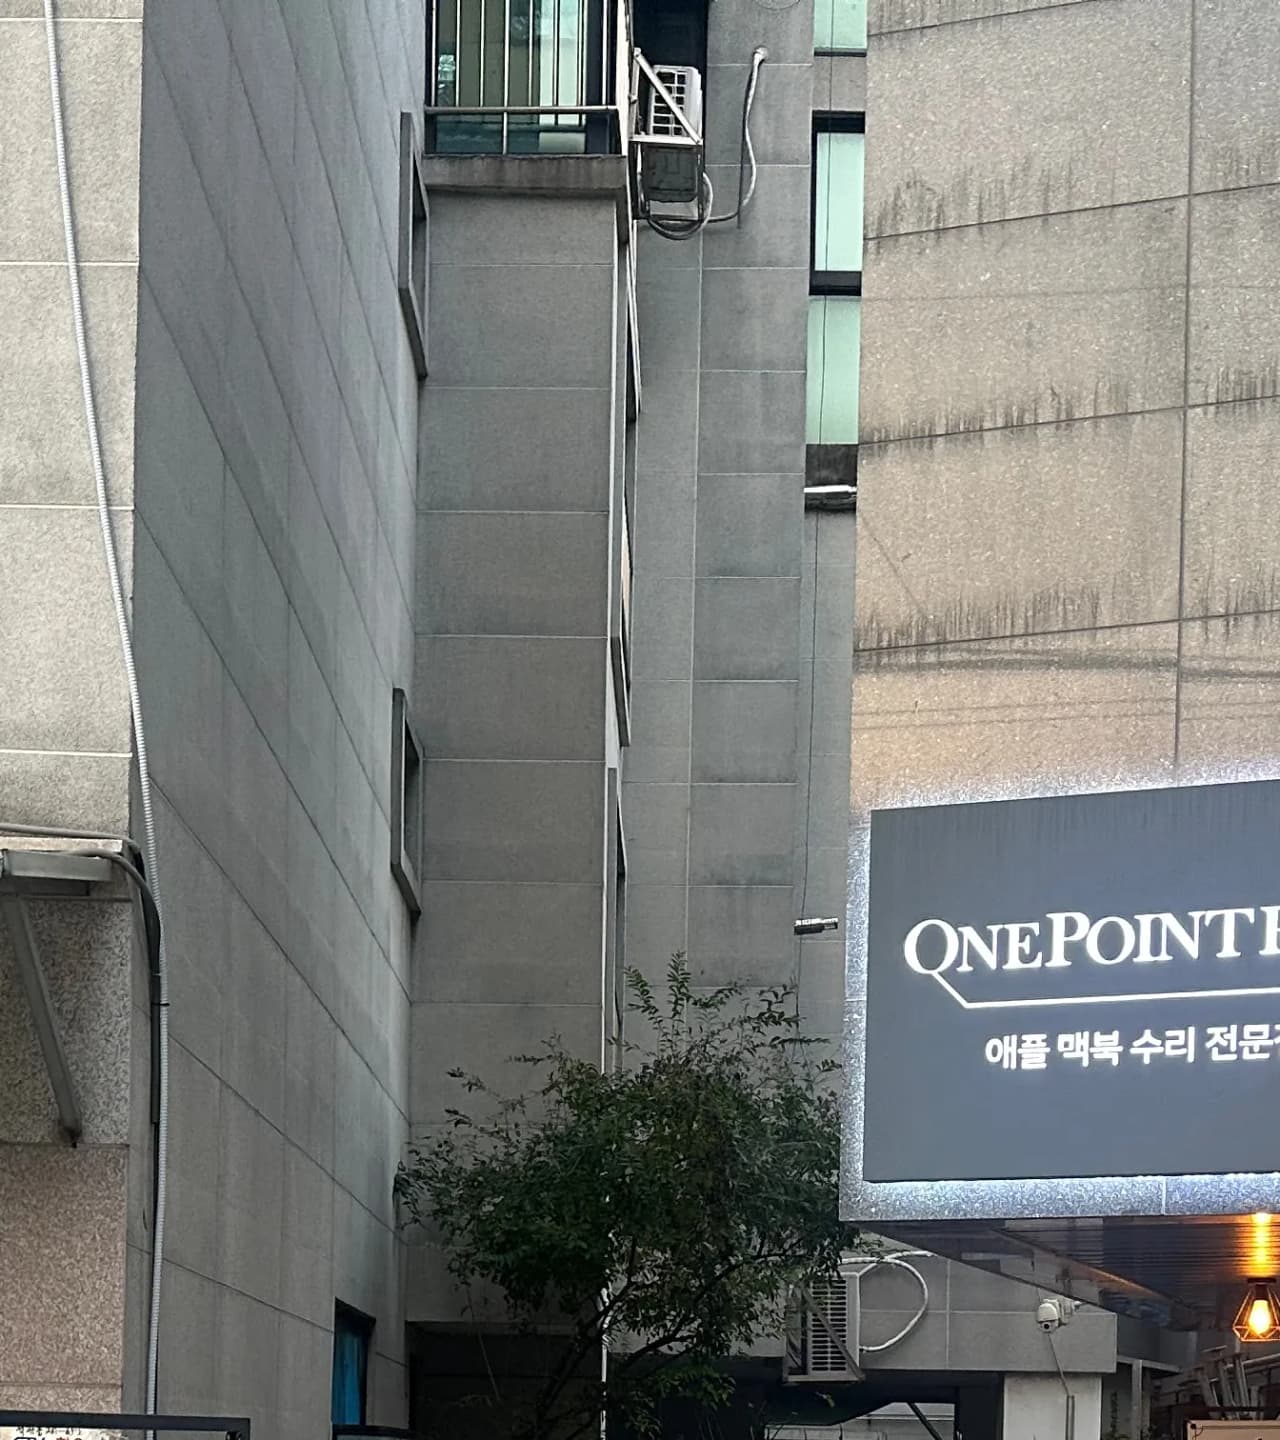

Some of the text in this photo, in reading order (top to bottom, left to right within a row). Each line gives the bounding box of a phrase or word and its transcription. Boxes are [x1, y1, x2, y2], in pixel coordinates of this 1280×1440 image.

[985, 1031, 1052, 1071] 애플
[1057, 1029, 1124, 1067] 맥북
[1129, 1025, 1196, 1064] 수리
